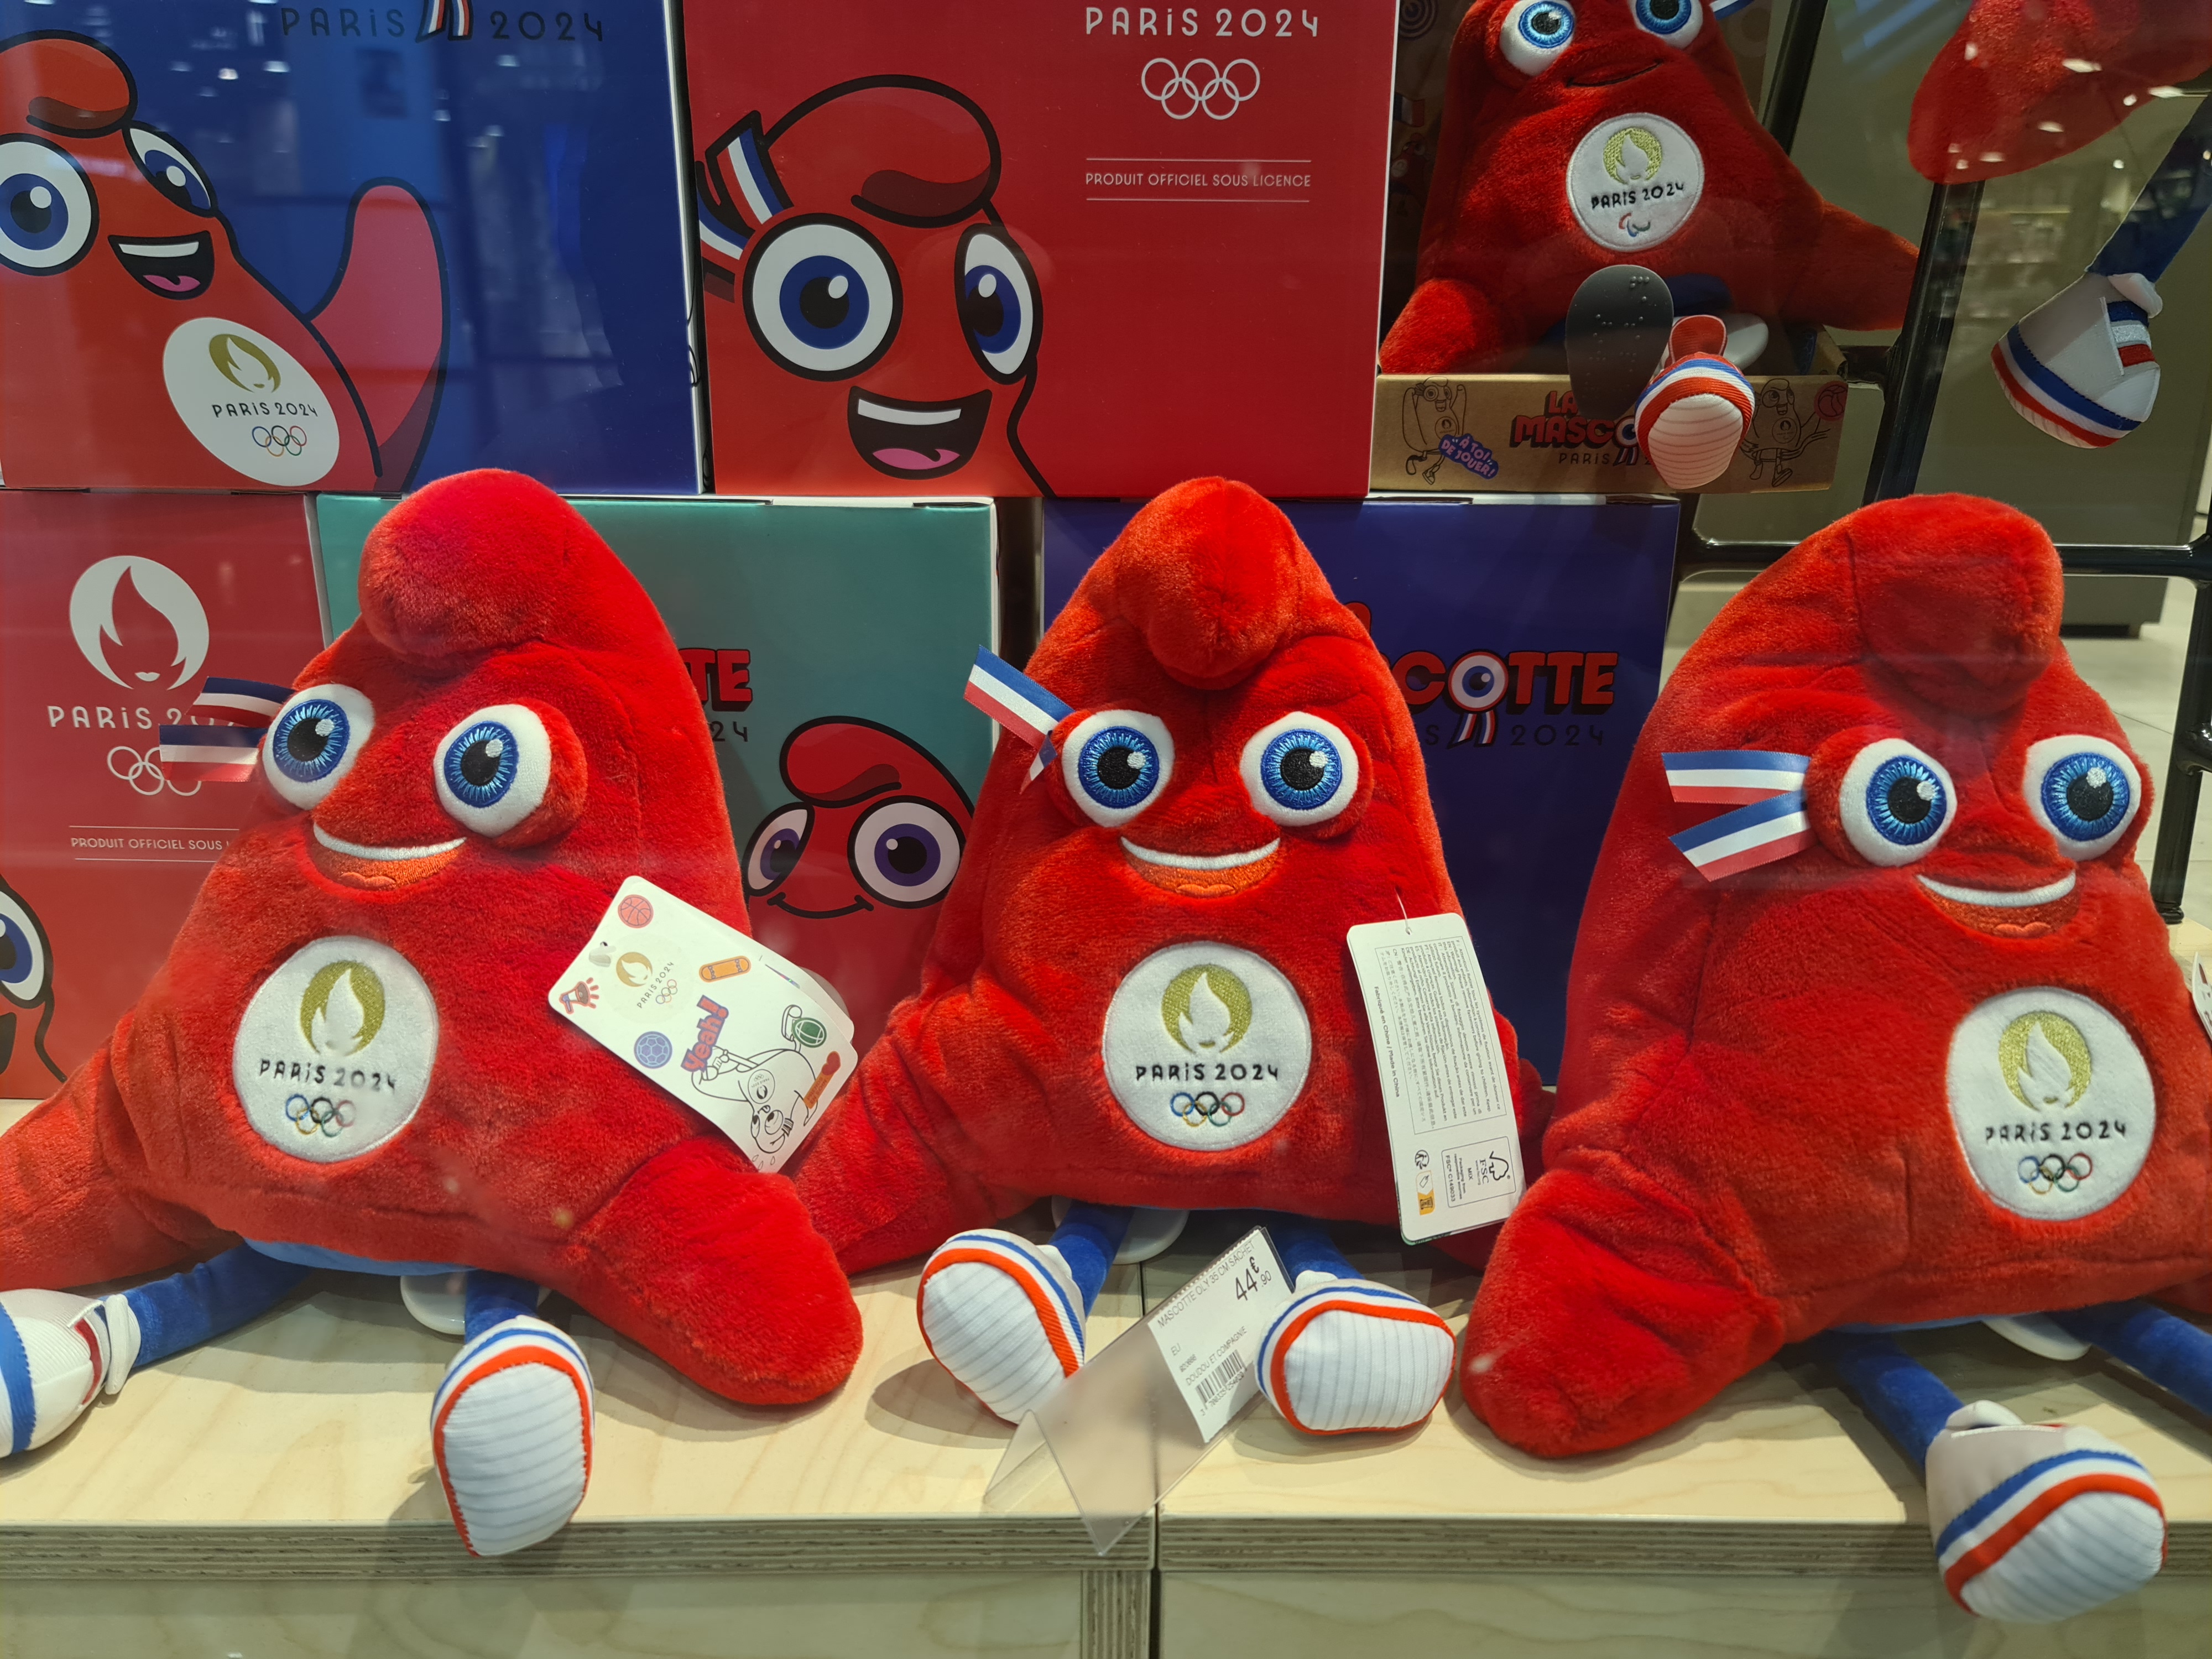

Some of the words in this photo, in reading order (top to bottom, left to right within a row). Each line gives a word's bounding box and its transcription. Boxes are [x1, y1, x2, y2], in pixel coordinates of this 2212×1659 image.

[281, 8, 405, 36] PARIS
[490, 11, 603, 41] 2024
[1086, 7, 1198, 36] PARIS
[1215, 9, 1318, 37] 2024
[1086, 173, 1144, 186] PRODUIT
[1148, 174, 1208, 186] OFFICIEL
[1212, 174, 1248, 187] SOUS
[1253, 175, 1311, 187] LICENCE
[1591, 191, 1637, 210] PARIS
[1642, 182, 1684, 201] 2024
[212, 402, 270, 418] PARIS
[275, 402, 318, 418] 2024
[1509, 415, 1637, 449] MASCO
[1559, 452, 1610, 466] PARIS
[48, 706, 153, 729] PARIS
[709, 721, 748, 742] 24
[1510, 724, 1603, 746] 2024
[71, 837, 124, 848] PRODUIT
[128, 838, 185, 850] OFFICIEL
[189, 839, 222, 851] SOUS
[1374, 986, 1384, 1014] Fabriqué
[1380, 1015, 1386, 1024] en
[1383, 1025, 1391, 1045] Chine
[1387, 1050, 1396, 1068] Made
[1392, 1077, 1401, 1097] China
[260, 1058, 325, 1084] PARIS
[334, 1068, 397, 1094] 2024
[1136, 1063, 1205, 1081] PARIS
[1215, 1063, 1279, 1081] 2024
[1985, 1122, 2050, 1142] PARIS
[2061, 1120, 2126, 1140] 2024
[1479, 1159, 1489, 1184] FSC
[1157, 1290, 1196, 1328] MASCOTTE
[1196, 1279, 1210, 1296] OLY
[1209, 1271, 1219, 1284] 35
[1218, 1261, 1230, 1276] CM
[1228, 1240, 1255, 1267] SACHET
[1171, 1342, 1181, 1357] EU
[1186, 1359, 1210, 1385] DOUDOU
[1209, 1353, 1217, 1364] ET
[1216, 1325, 1246, 1357] COMPAGNIE
